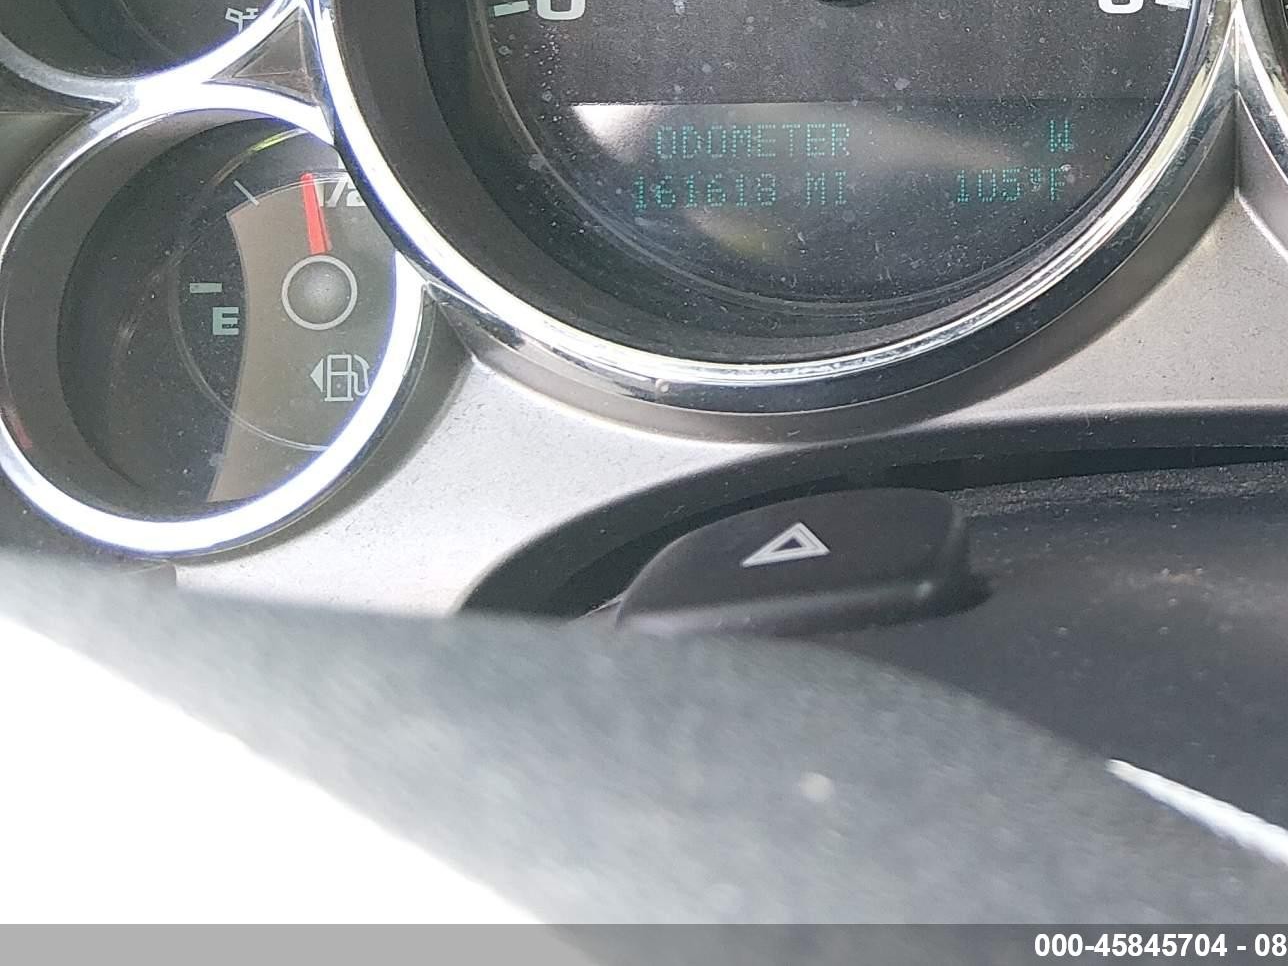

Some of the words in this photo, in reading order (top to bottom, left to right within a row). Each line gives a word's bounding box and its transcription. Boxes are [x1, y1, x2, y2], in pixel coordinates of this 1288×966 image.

[656, 121, 851, 160] ODOMETER
[1050, 118, 1070, 153] W
[806, 171, 848, 206] MI
[212, 306, 240, 336] E
